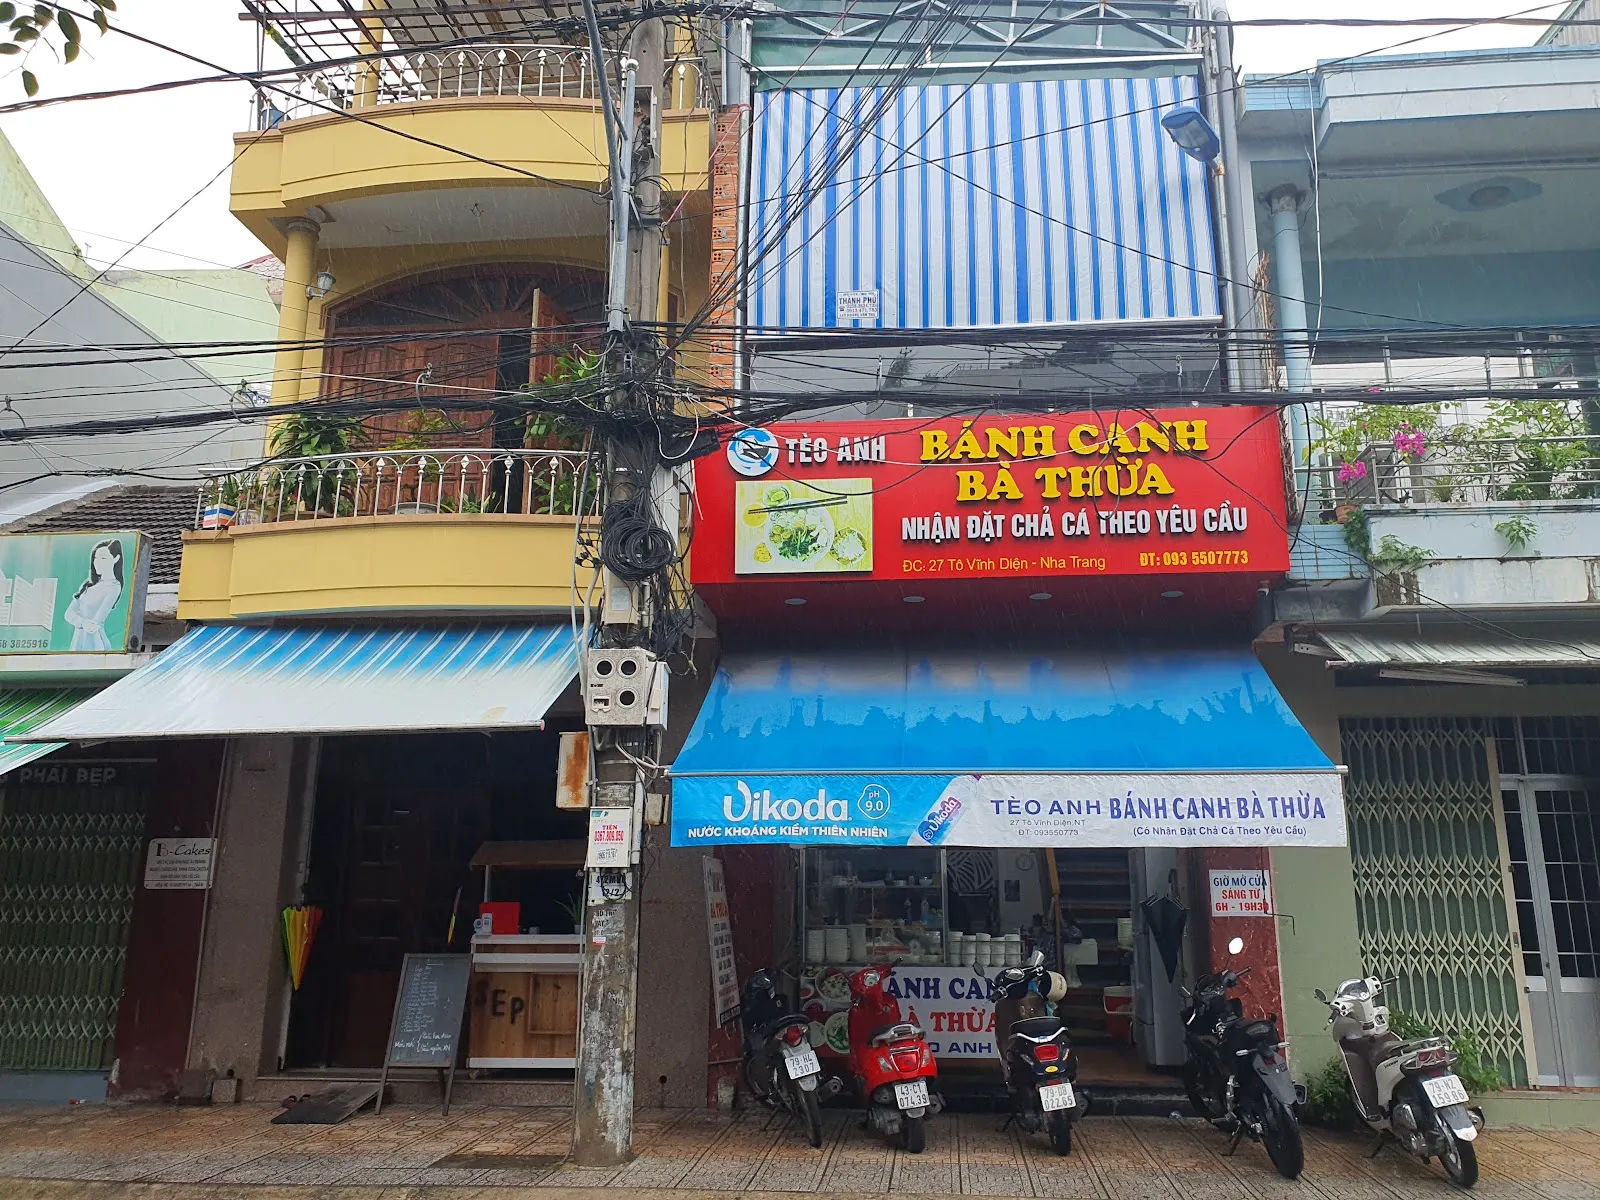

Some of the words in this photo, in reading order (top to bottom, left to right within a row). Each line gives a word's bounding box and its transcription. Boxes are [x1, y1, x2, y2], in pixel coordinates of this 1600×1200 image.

[785, 432, 828, 463] TÈO
[837, 435, 886, 462] ANH
[920, 420, 1056, 462] BÁNH
[1068, 420, 1209, 456] CANH
[956, 461, 1024, 501] BÀ
[1035, 456, 1175, 498] THỪA
[902, 512, 960, 543] NHẬN
[966, 510, 1005, 542] ĐẶT
[1011, 505, 1054, 537] CHẢ
[1061, 508, 1090, 536] CÁ
[1098, 510, 1151, 535] THEO
[1156, 504, 1197, 533] YÊU
[1203, 500, 1248, 532] CẦU
[902, 559, 926, 573] ĐC:
[928, 559, 943, 572] 27
[949, 558, 964, 571] Tô
[966, 557, 995, 571] Vĩnh
[1000, 556, 1028, 572] Diện
[1040, 556, 1066, 569] Nha
[1069, 554, 1105, 570] Trang
[1139, 551, 1160, 567] ĐT:
[1163, 551, 1188, 566] 093
[1192, 550, 1249, 565] 5507773
[722, 779, 849, 822] Vikoda
[868, 790, 880, 800] pH
[865, 800, 884, 813] 9.0
[990, 795, 1041, 815] TÈO
[1048, 799, 1101, 815] ANH
[1109, 791, 1168, 820] BÁNH
[1172, 797, 1231, 820] CANH
[1236, 791, 1265, 819] BÀ
[1268, 790, 1326, 820] THỪA
[930, 799, 957, 832] Vikoda
[688, 825, 722, 838] NƯỚC
[724, 824, 778, 837] KHOÁNG
[812, 824, 848, 837] THIÊN
[850, 825, 888, 838] NHIÊN
[1133, 826, 1150, 837] (Có
[1199, 825, 1219, 835] Chả
[1221, 825, 1235, 835] Cá
[1237, 826, 1261, 835] Theo
[1264, 825, 1283, 835] Yêu
[1213, 874, 1230, 887] GIỜ
[1222, 887, 1247, 900] SÁNG
[1215, 902, 1228, 912] 6H
[887, 970, 940, 999] ÁNH
[948, 1042, 992, 1054] ANH
